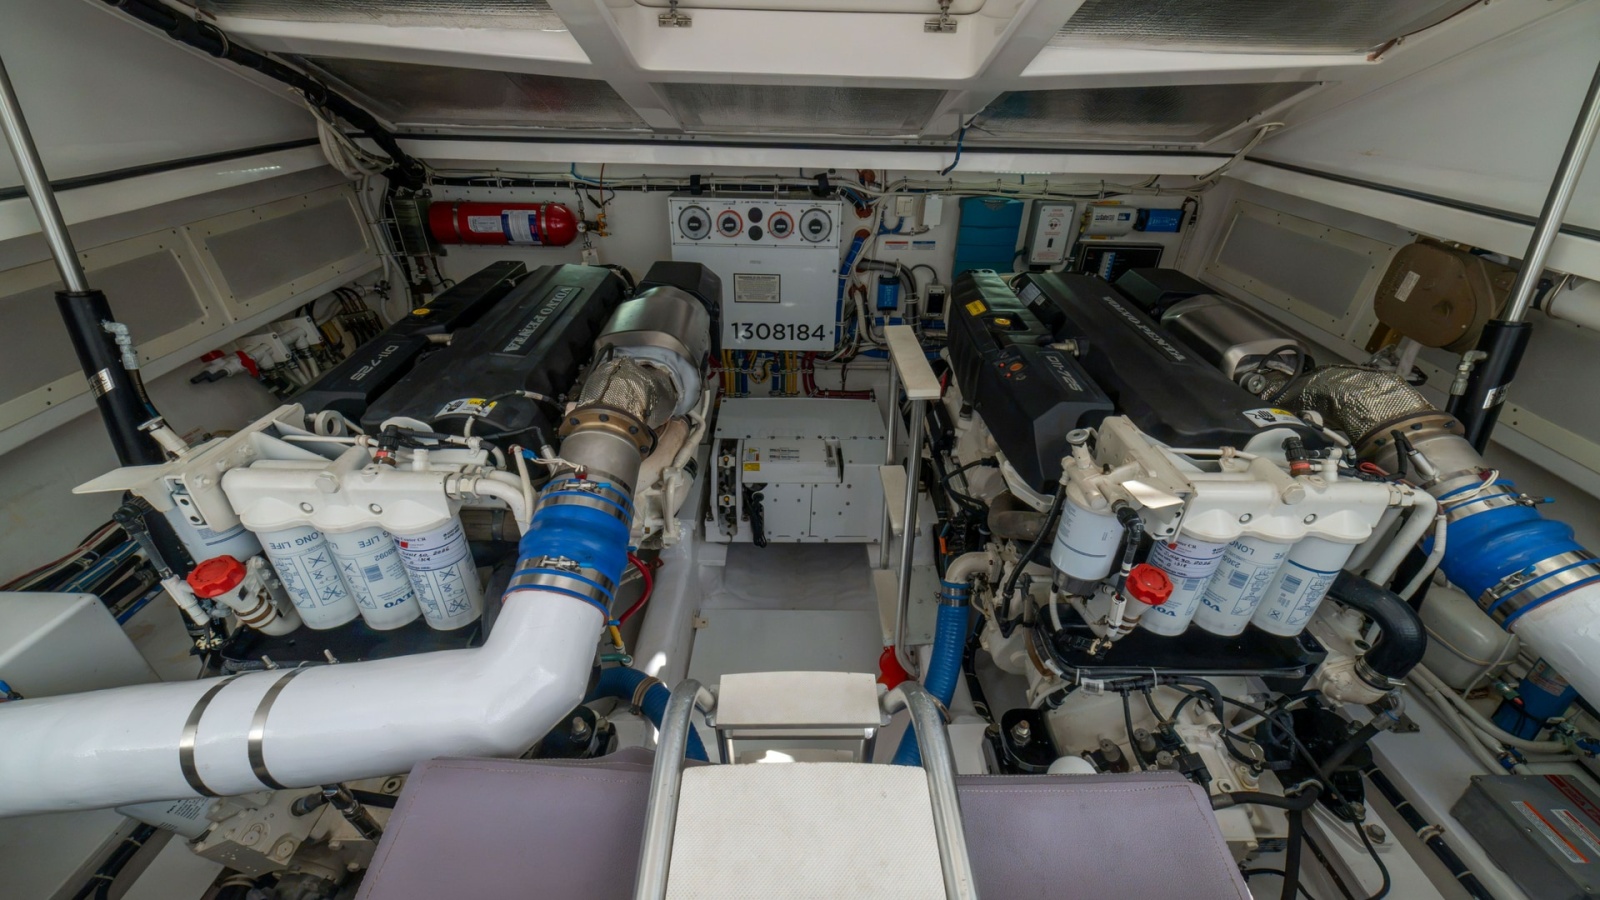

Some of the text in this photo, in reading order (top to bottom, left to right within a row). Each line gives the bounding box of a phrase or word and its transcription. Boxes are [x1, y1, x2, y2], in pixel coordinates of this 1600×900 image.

[503, 287, 574, 353] VOLVO PENTA
[731, 322, 826, 342] 1308184
[349, 345, 400, 381] D11-725
[269, 531, 324, 550] ONG LIFE
[358, 535, 381, 549] LIFE
